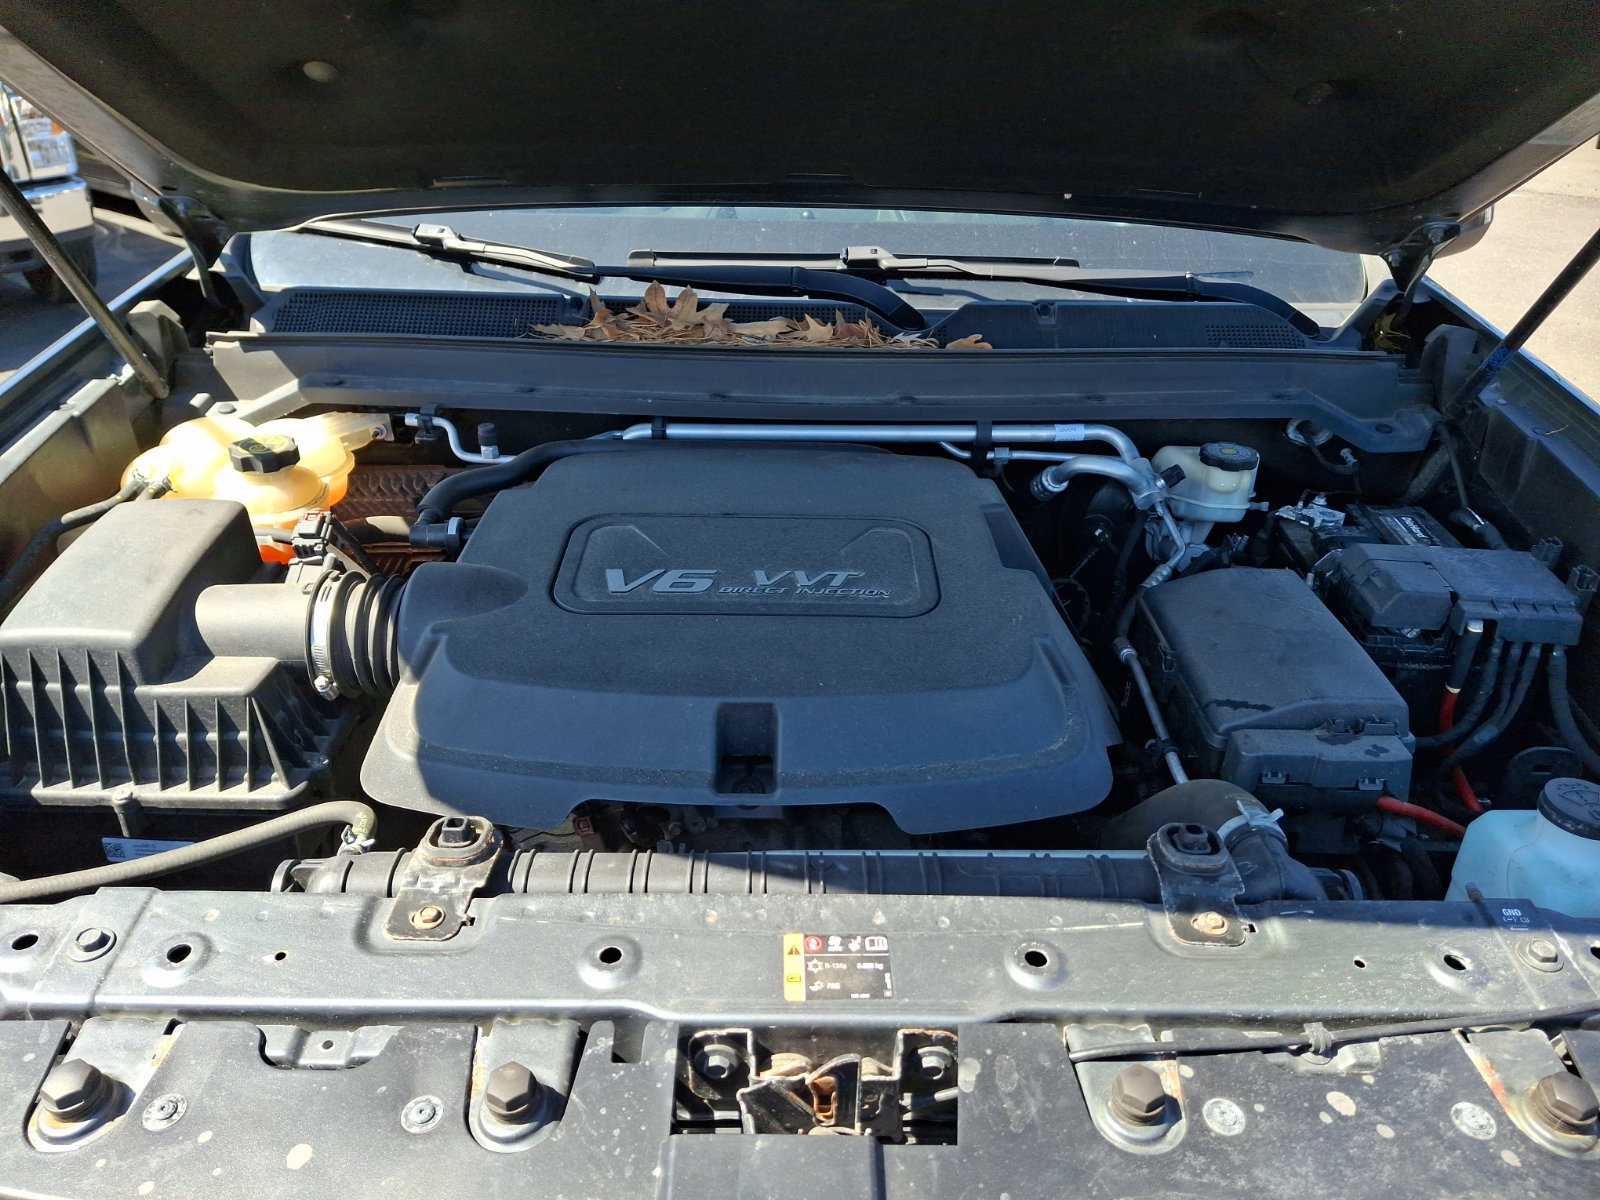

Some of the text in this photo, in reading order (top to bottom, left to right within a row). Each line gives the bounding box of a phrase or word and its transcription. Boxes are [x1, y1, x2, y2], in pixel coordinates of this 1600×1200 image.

[605, 568, 866, 594] V6 VVT
[718, 586, 893, 598] DIRECT INJECTION
[1502, 908, 1521, 916] GND
